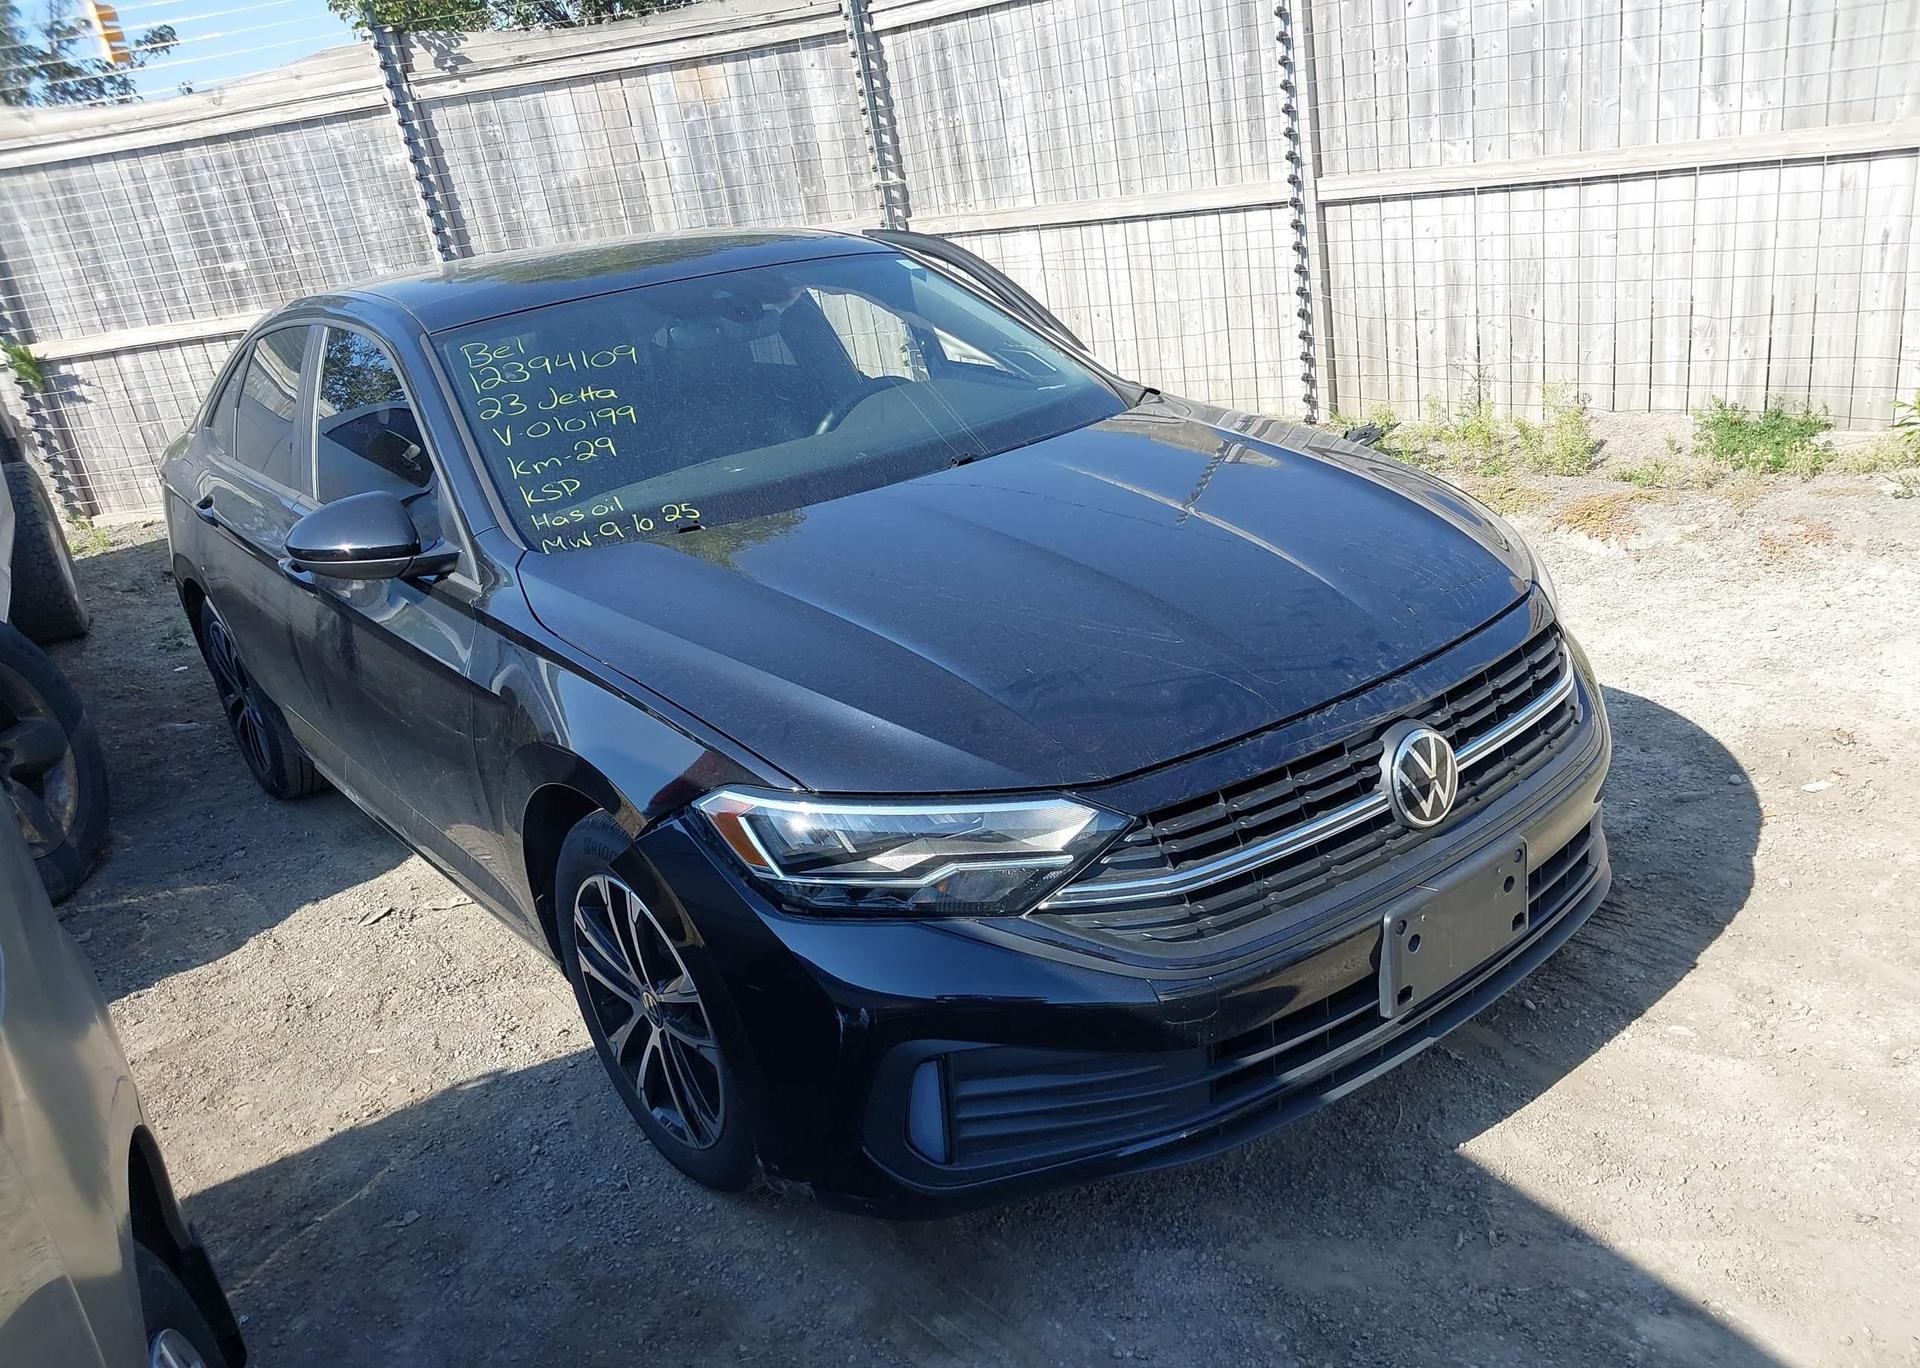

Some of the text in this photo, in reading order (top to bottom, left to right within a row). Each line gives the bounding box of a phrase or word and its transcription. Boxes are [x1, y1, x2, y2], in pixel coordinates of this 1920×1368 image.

[468, 345, 638, 394] 12394109
[477, 386, 618, 420] 23 Jetta
[531, 496, 624, 531] Has oil
[662, 503, 700, 520] 25
[1393, 731, 1454, 820] VW
